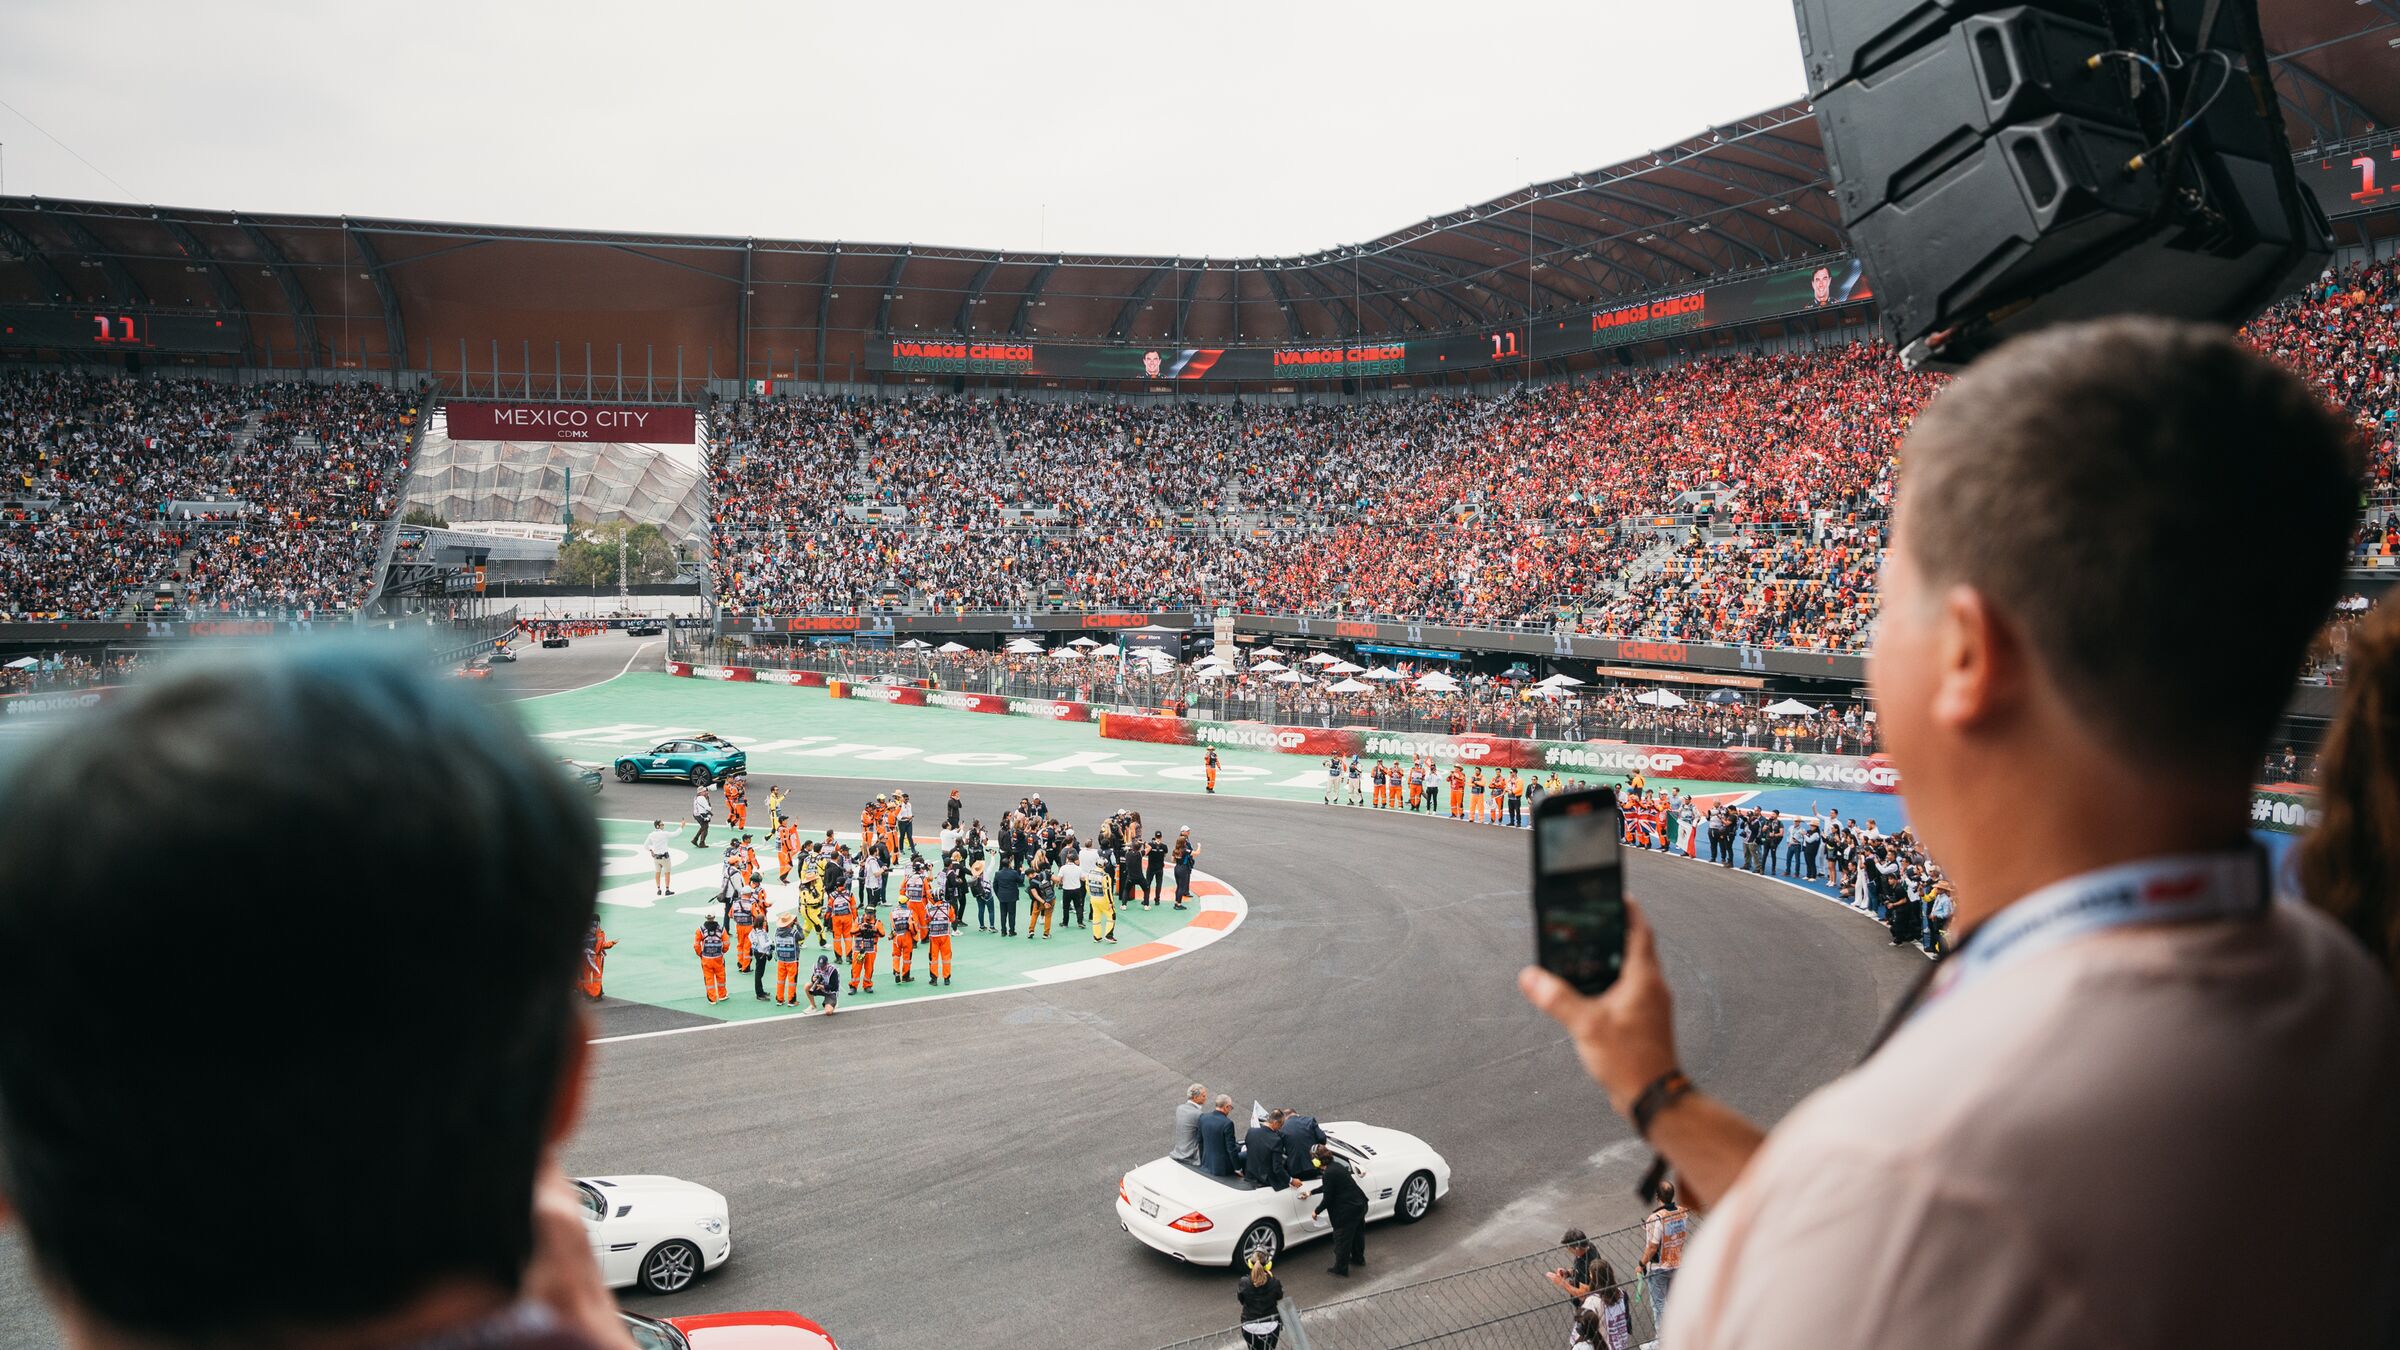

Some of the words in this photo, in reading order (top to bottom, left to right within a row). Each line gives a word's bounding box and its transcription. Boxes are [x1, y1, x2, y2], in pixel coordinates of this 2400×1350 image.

[94, 315, 141, 342] 11
[1491, 331, 1520, 360] 11
[494, 408, 588, 427] MEXICO
[596, 410, 650, 428] CITY
[557, 430, 589, 438] CDMX
[752, 617, 776, 631] 11
[872, 616, 895, 630] 11
[1012, 615, 1035, 628] 11
[1297, 619, 1311, 634] 11
[1407, 625, 1423, 642] 11
[1553, 635, 1574, 655] 11
[1739, 648, 1766, 671] 11
[693, 667, 734, 679] #MexicoGP
[756, 671, 802, 683] #MexicoGP
[851, 686, 901, 700] #MexicoGP
[926, 693, 980, 708] #MexicoGP
[1009, 701, 1070, 716] #MexicoGP
[1196, 726, 1306, 749] #MexicoGP
[1366, 737, 1491, 760] #MexicoGP
[1545, 747, 1684, 772] #MexicoGP
